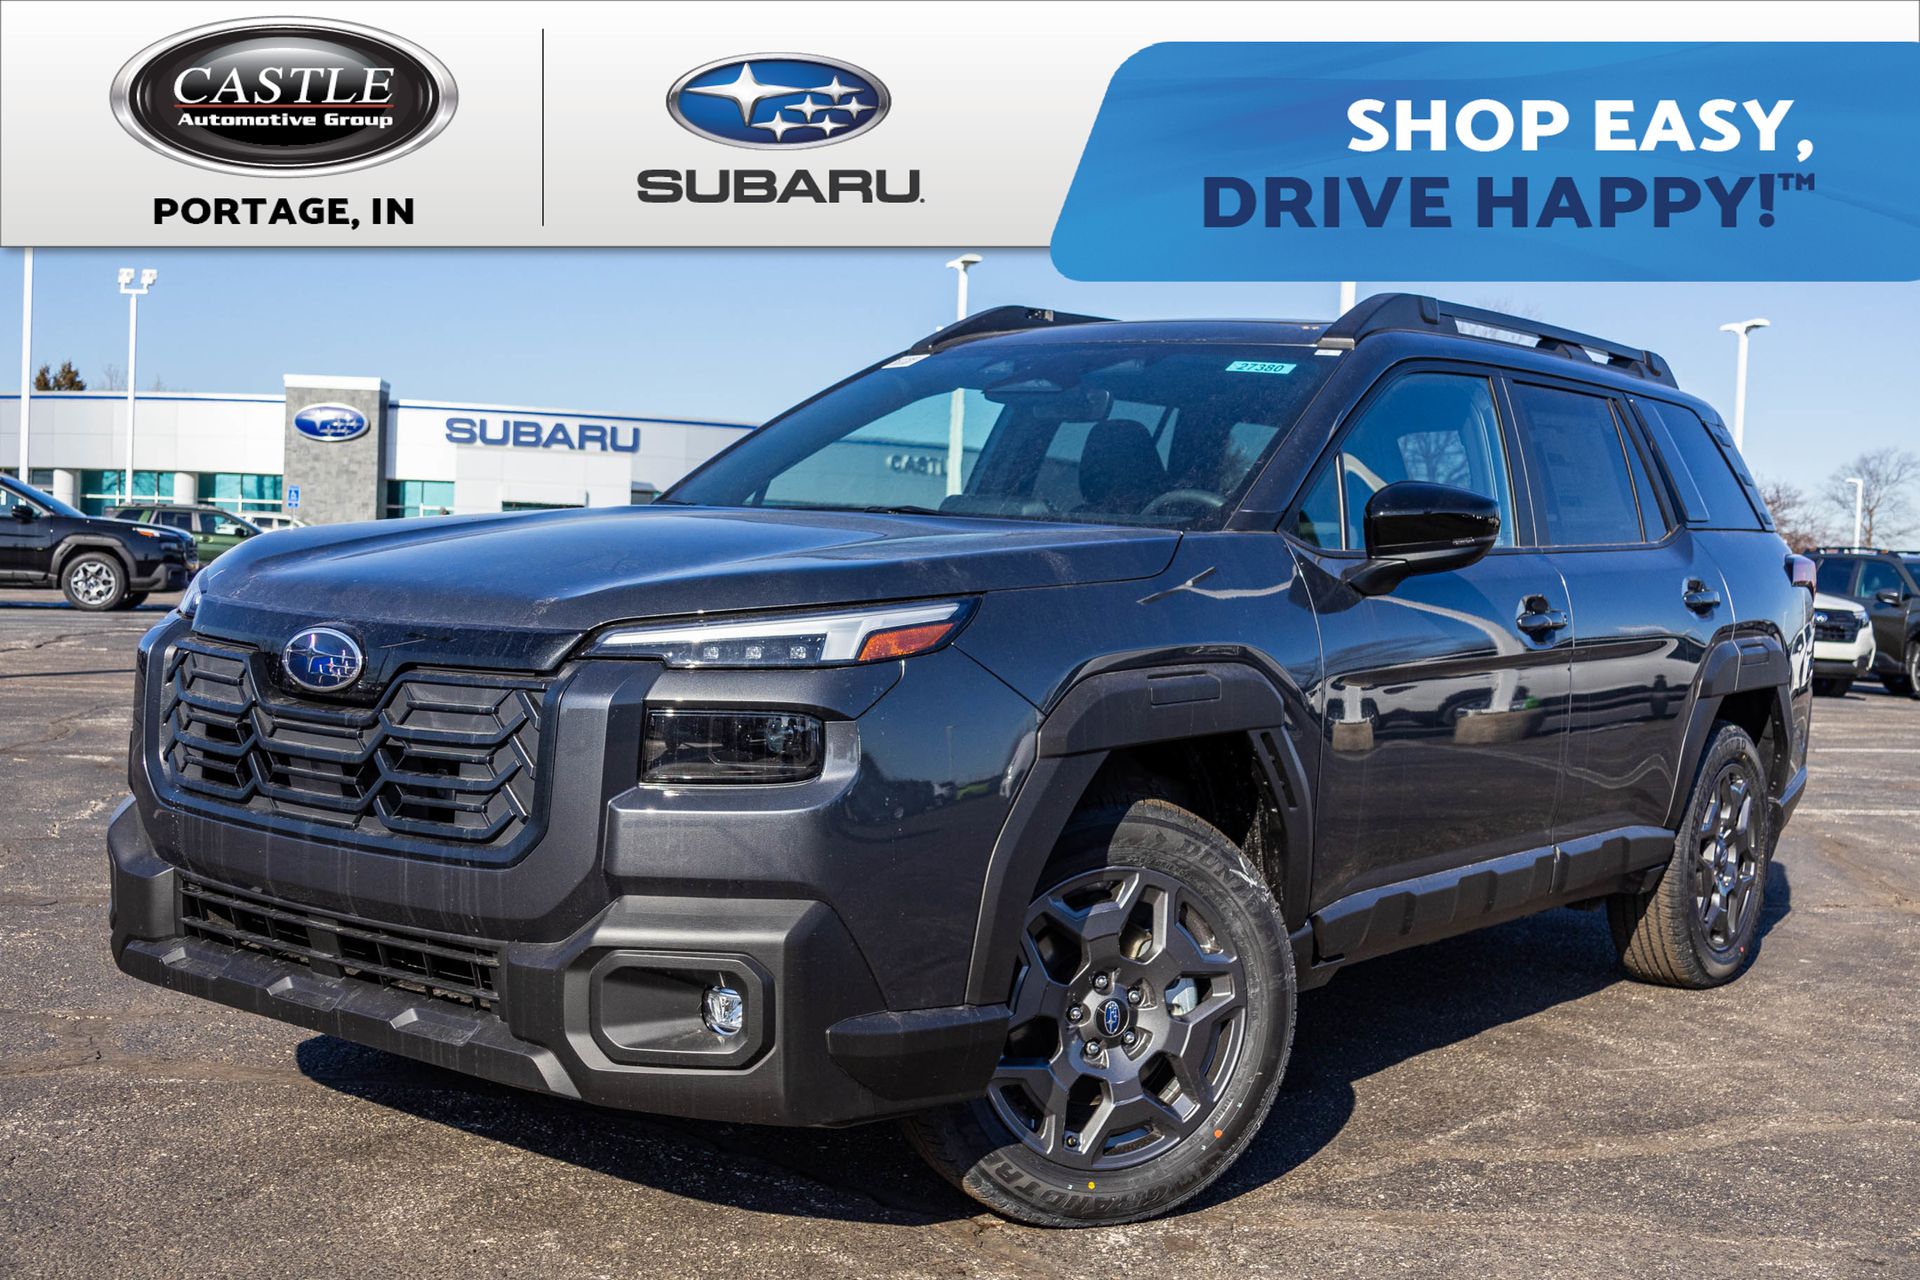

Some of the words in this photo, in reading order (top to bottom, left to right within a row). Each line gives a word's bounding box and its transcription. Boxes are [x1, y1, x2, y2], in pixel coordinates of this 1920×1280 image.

[1236, 362, 1285, 373] 27380
[445, 417, 641, 453] SUBARU
[887, 455, 949, 476] CASTL
